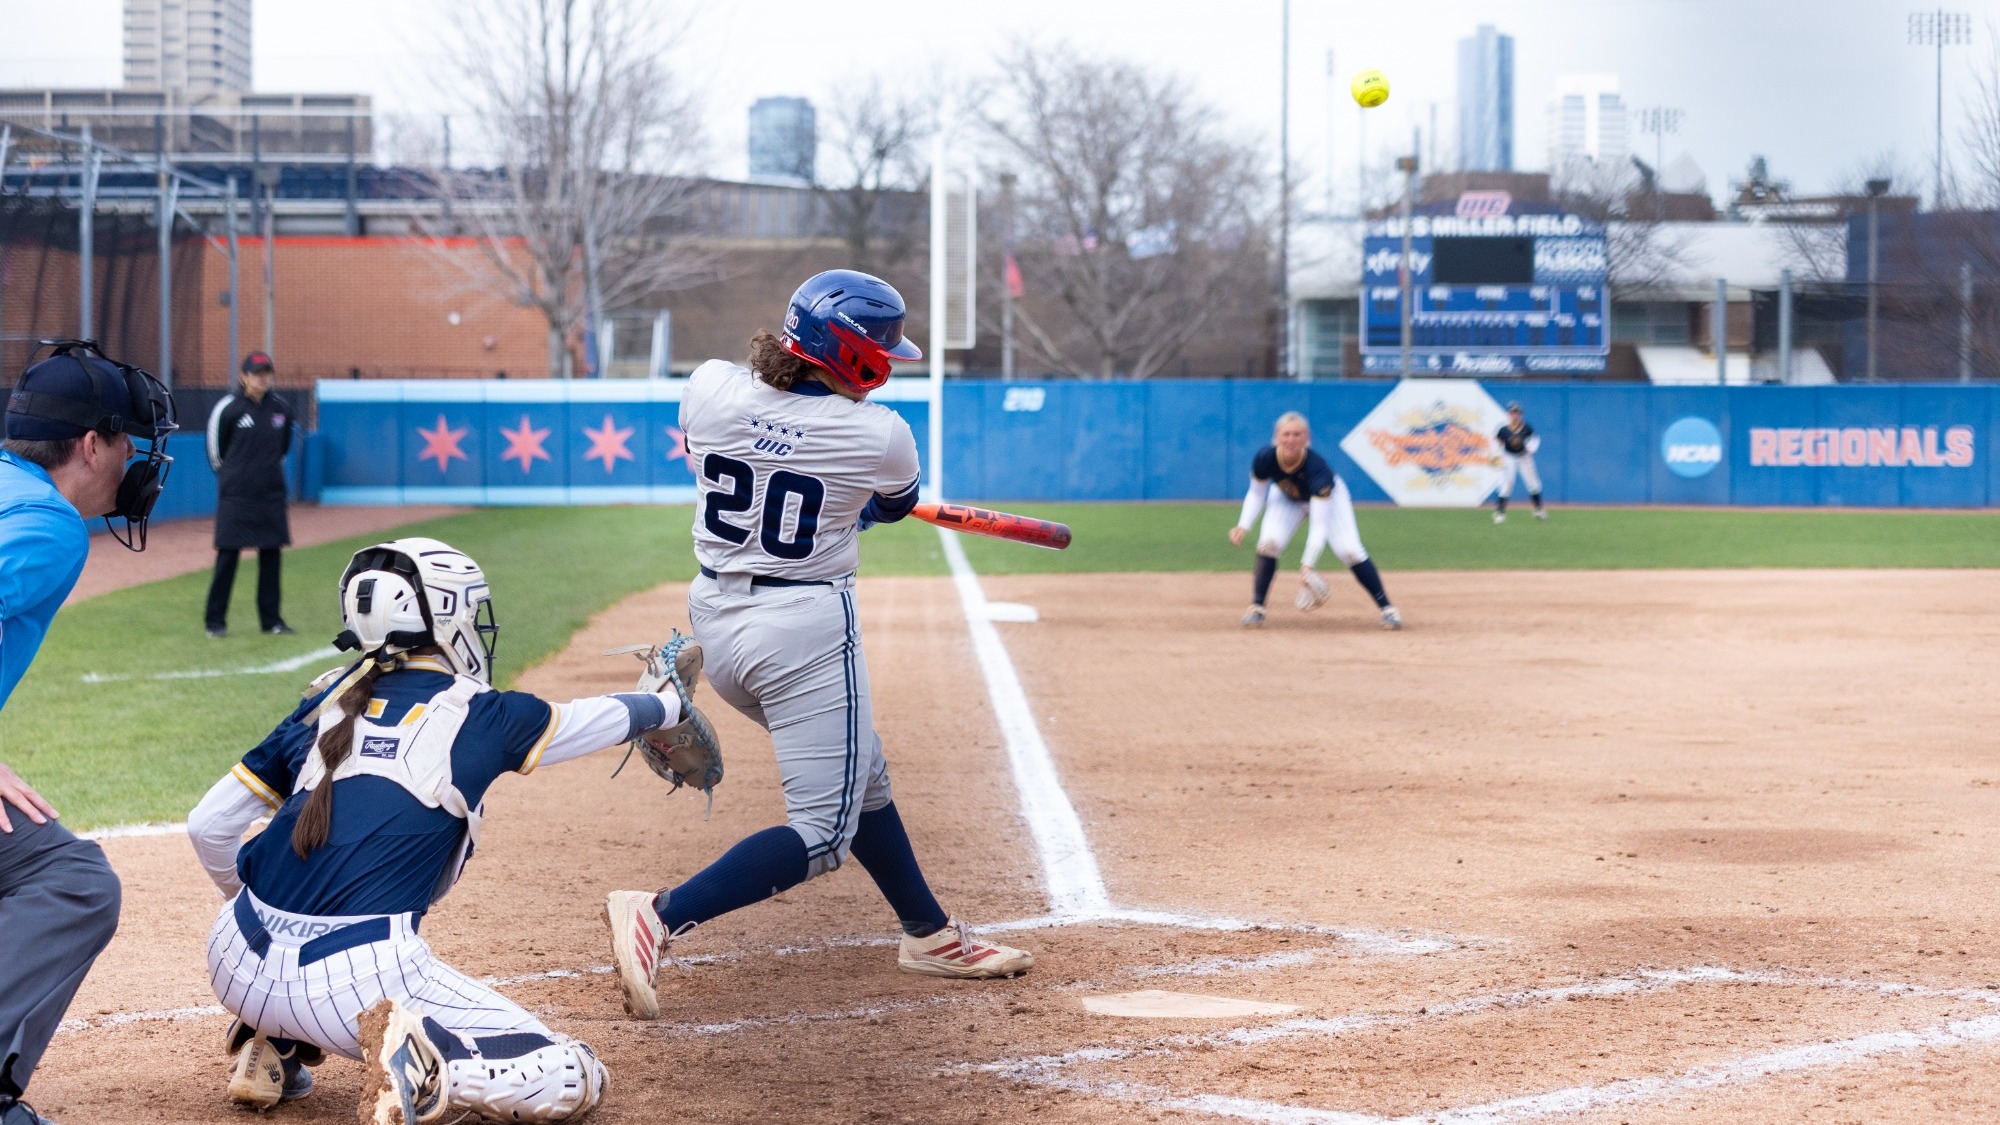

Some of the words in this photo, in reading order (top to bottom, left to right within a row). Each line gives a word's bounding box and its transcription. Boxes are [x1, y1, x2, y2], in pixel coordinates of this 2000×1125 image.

[1432, 215, 1515, 237] MILLER
[1517, 214, 1582, 236] FIELD
[787, 312, 799, 330] 20
[754, 436, 795, 457] UIC
[1750, 426, 1974, 467] REGIONALS
[703, 453, 826, 561] 20
